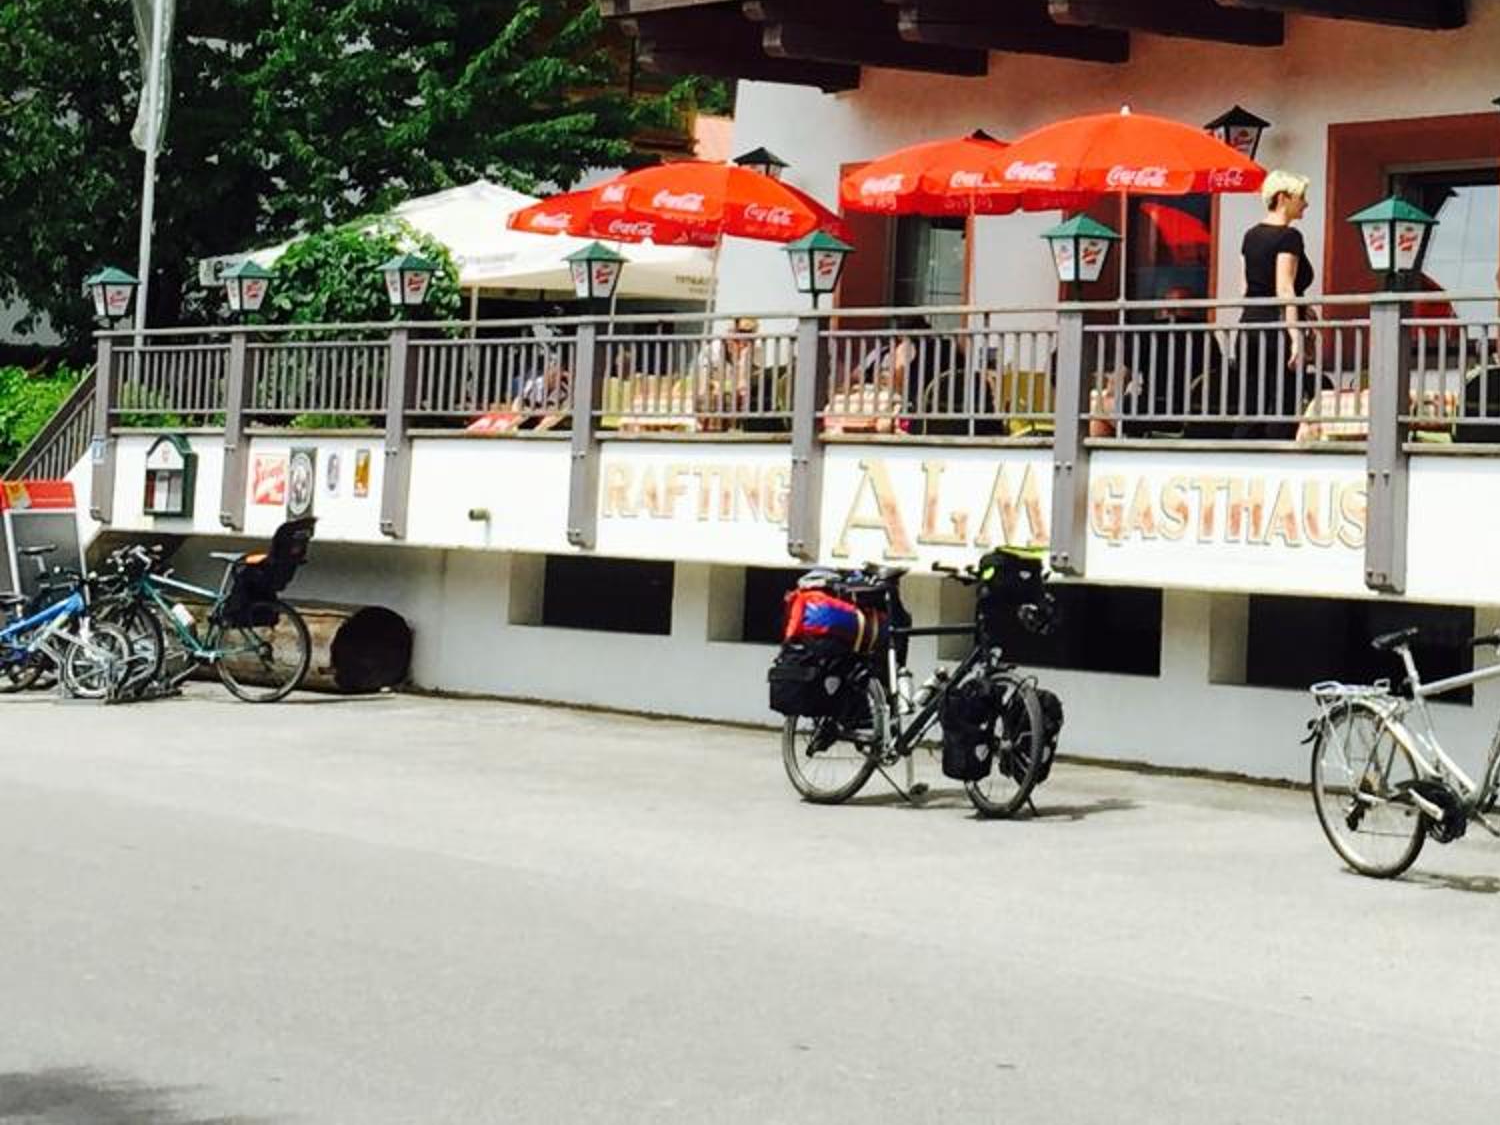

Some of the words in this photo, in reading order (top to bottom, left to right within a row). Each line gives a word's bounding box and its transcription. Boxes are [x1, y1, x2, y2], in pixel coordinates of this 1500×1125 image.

[602, 464, 791, 523] RAFTING
[832, 458, 1050, 559] ALM
[1091, 475, 1367, 548] GASTHAUS
